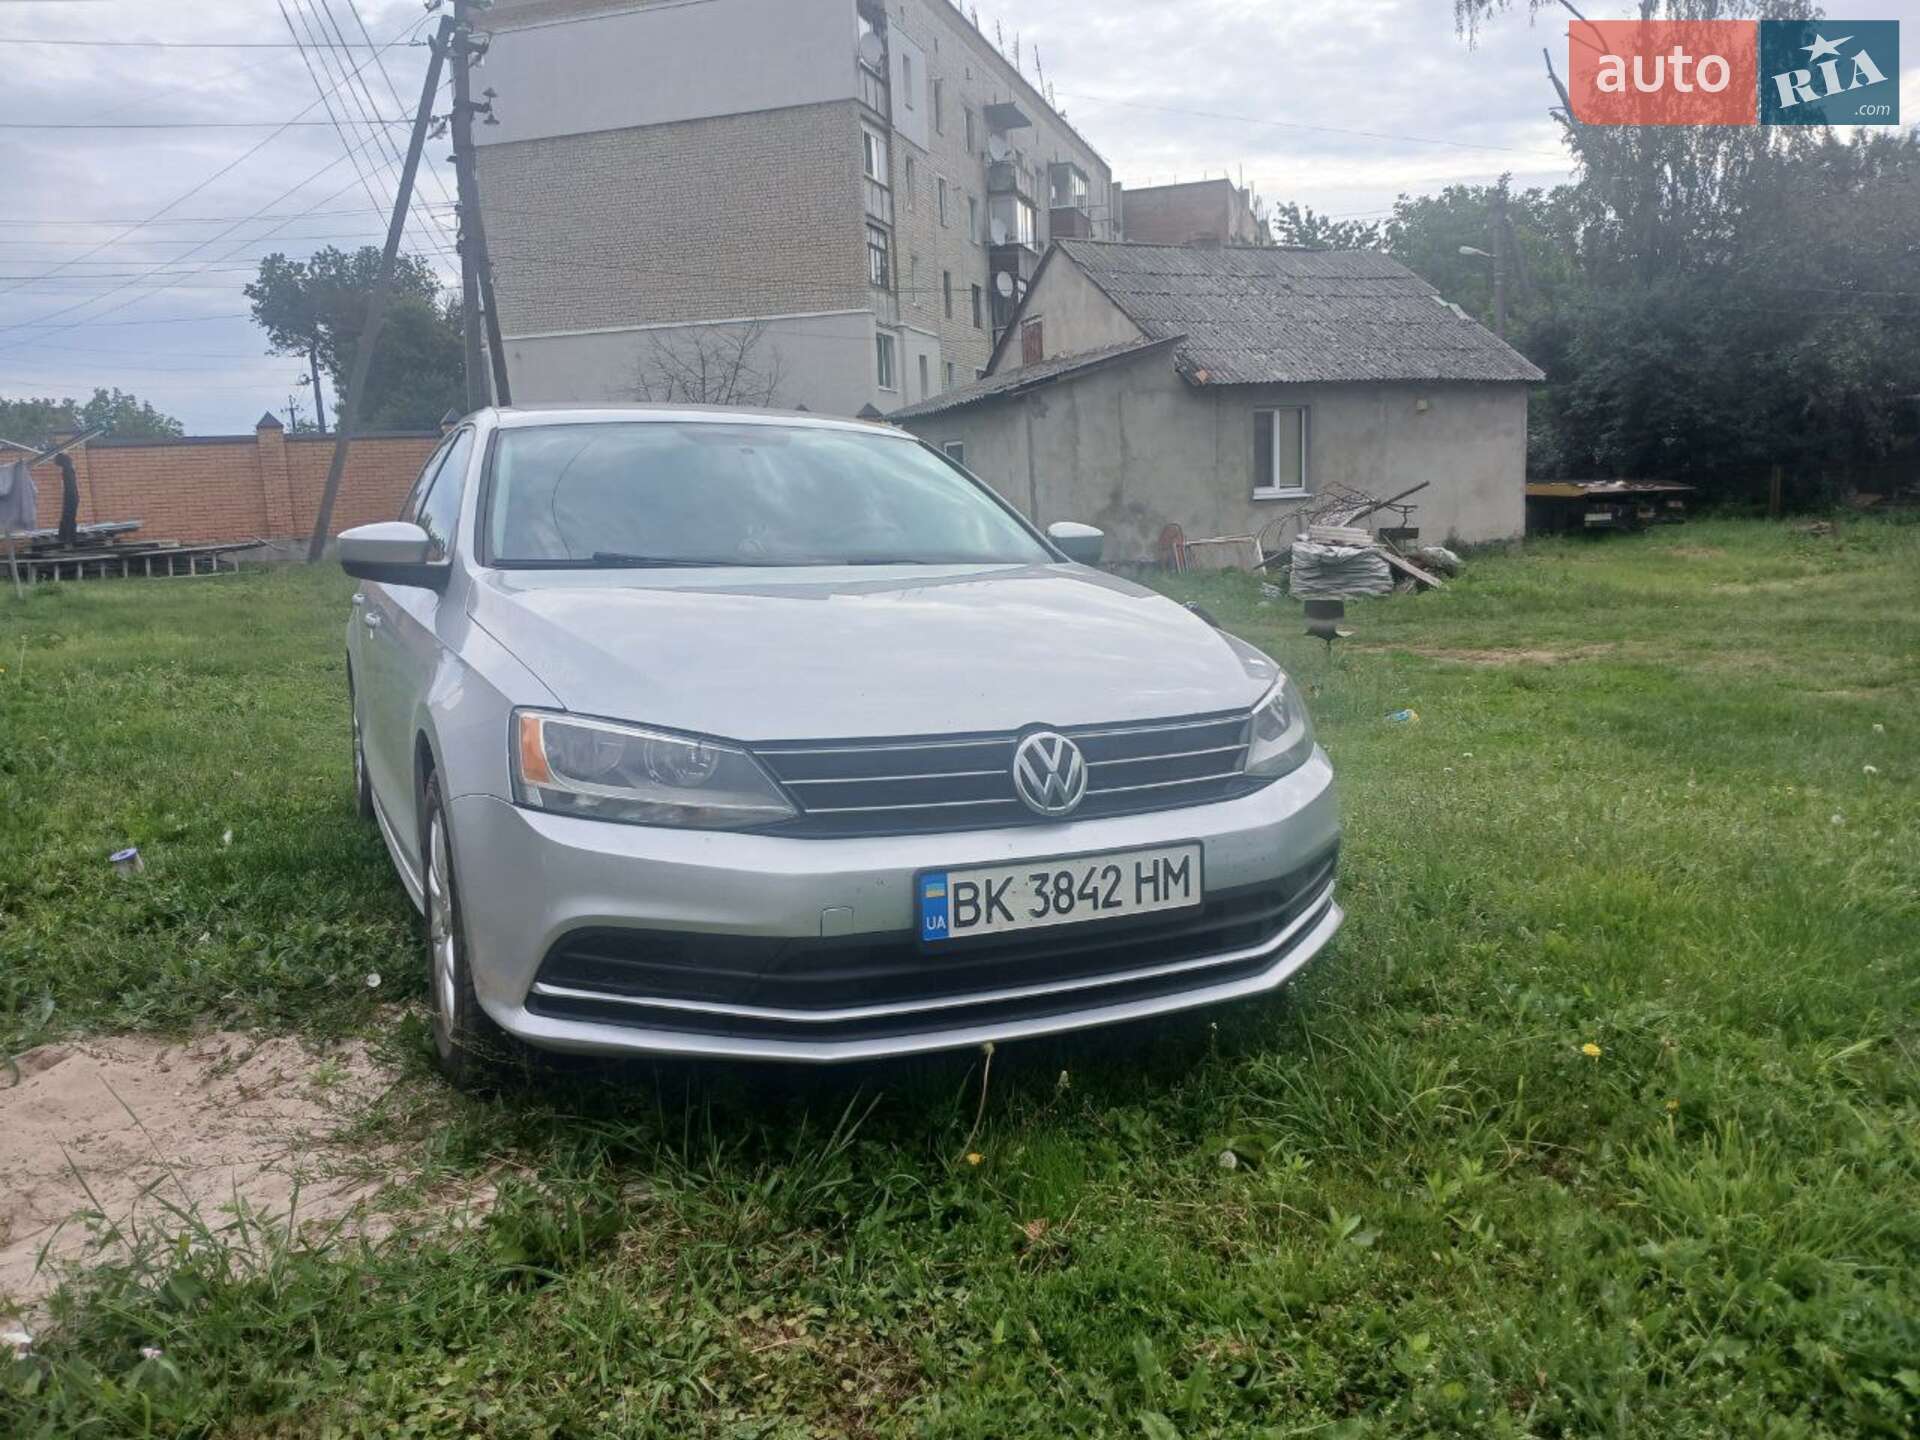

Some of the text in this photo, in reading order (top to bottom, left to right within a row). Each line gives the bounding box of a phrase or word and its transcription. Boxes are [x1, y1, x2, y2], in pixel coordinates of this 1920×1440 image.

[953, 855, 1190, 928] BK 3842 HM
[926, 915, 946, 930] UA
